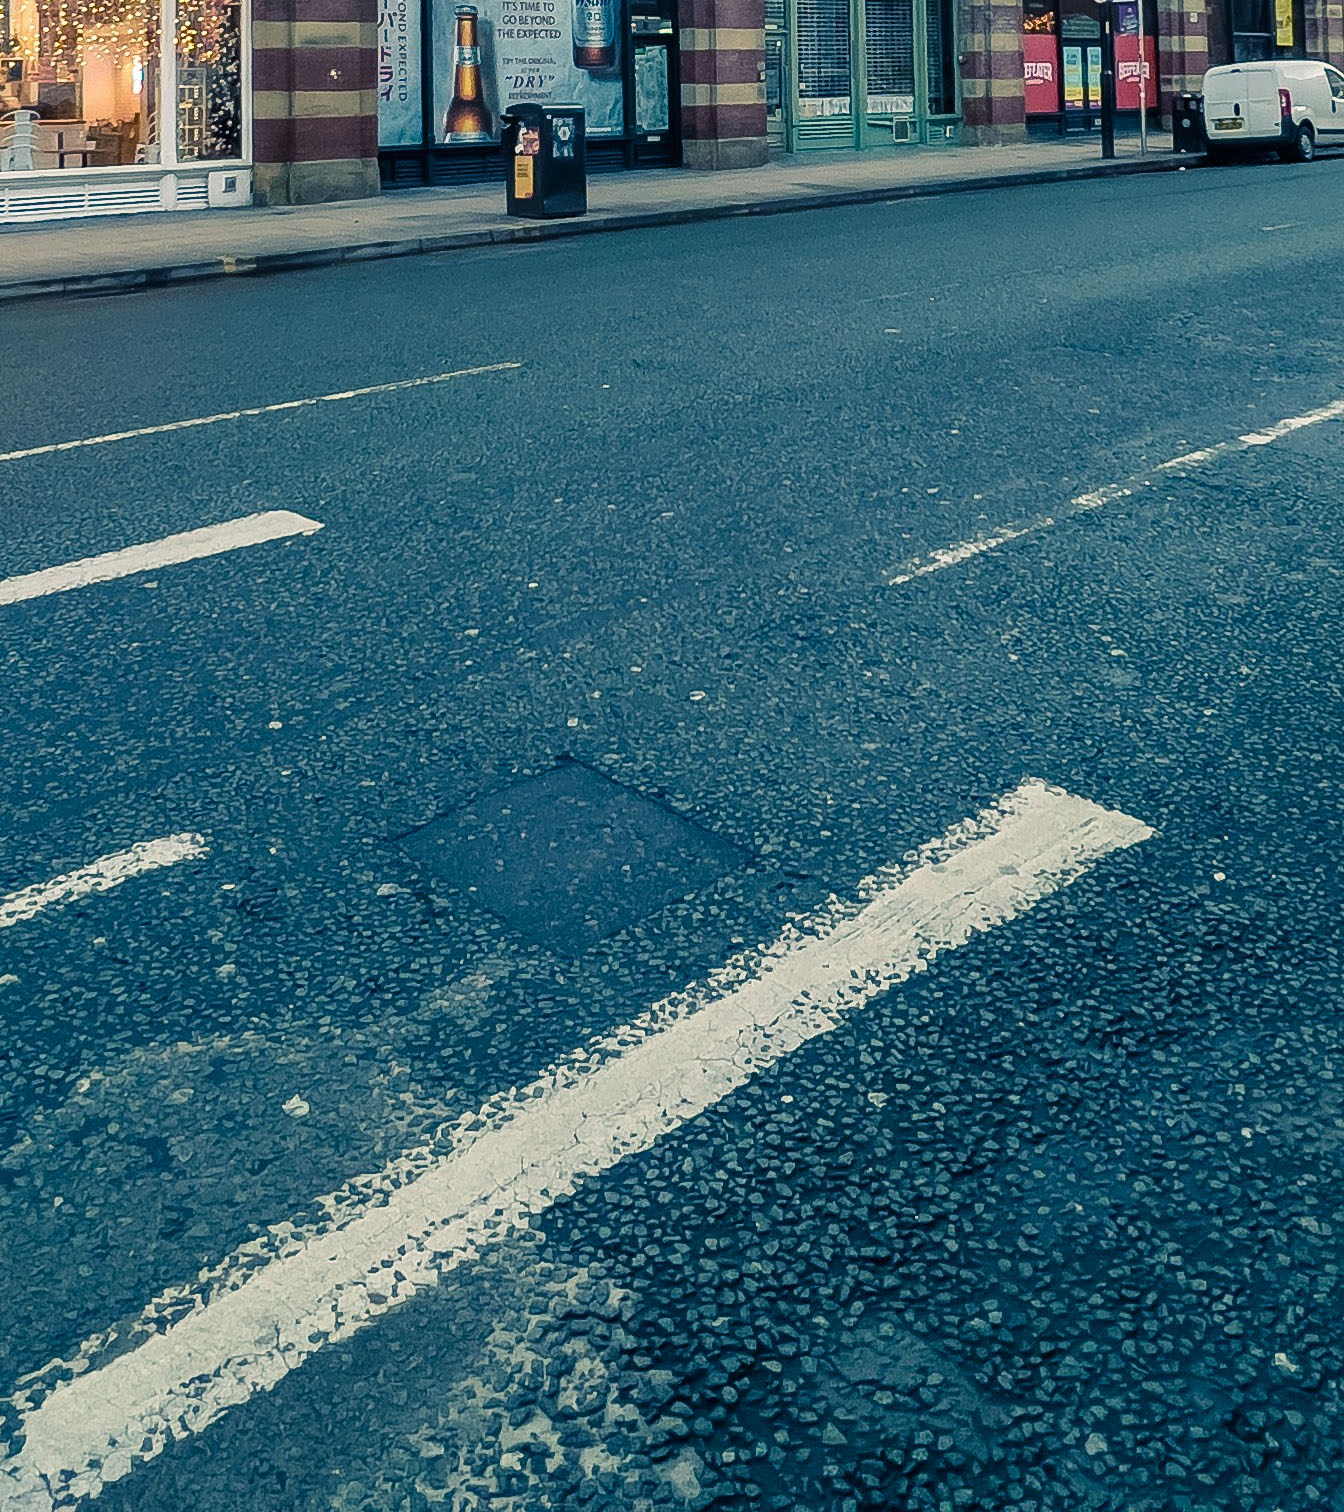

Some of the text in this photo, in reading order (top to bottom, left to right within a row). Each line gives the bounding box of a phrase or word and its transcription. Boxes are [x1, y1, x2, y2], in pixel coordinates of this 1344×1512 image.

[519, 1, 541, 13] TIME
[542, 2, 555, 13] TO
[502, 14, 556, 27] GO BEYOND
[497, 28, 562, 40] THE EXPECTED
[397, 35, 408, 103] EXPECTED
